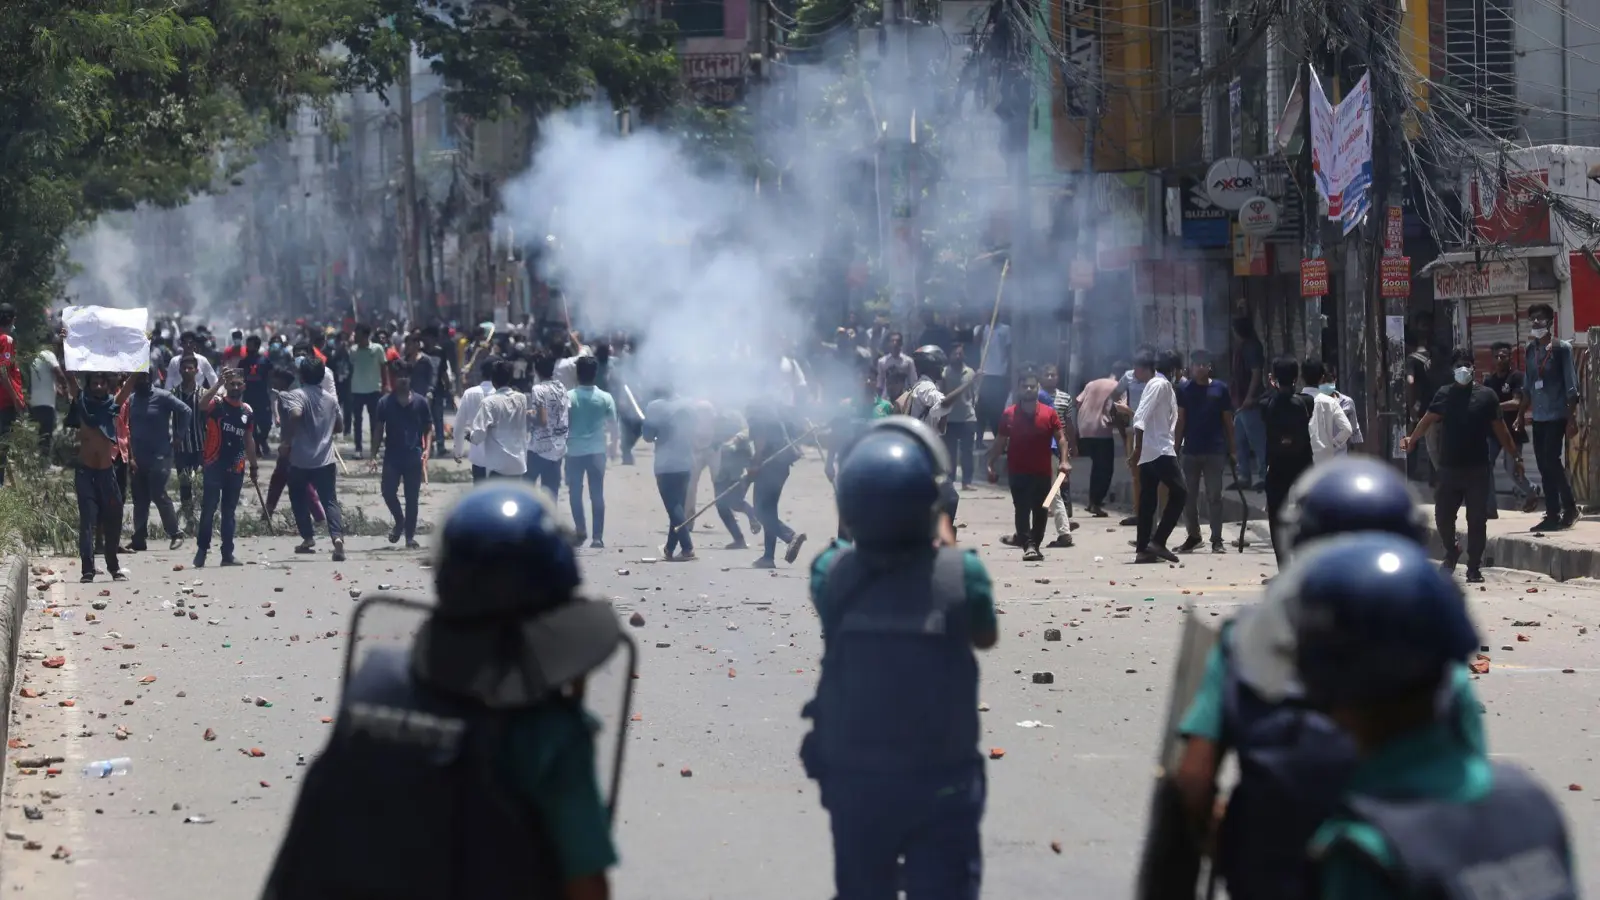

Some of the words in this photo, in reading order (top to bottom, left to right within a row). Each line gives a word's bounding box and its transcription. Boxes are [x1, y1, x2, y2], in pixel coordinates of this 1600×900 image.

[1213, 177, 1253, 191] AXOR
[1185, 210, 1226, 218] SUZUKI
[1303, 279, 1327, 287] Zoom
[1382, 279, 1409, 287] Zoom
